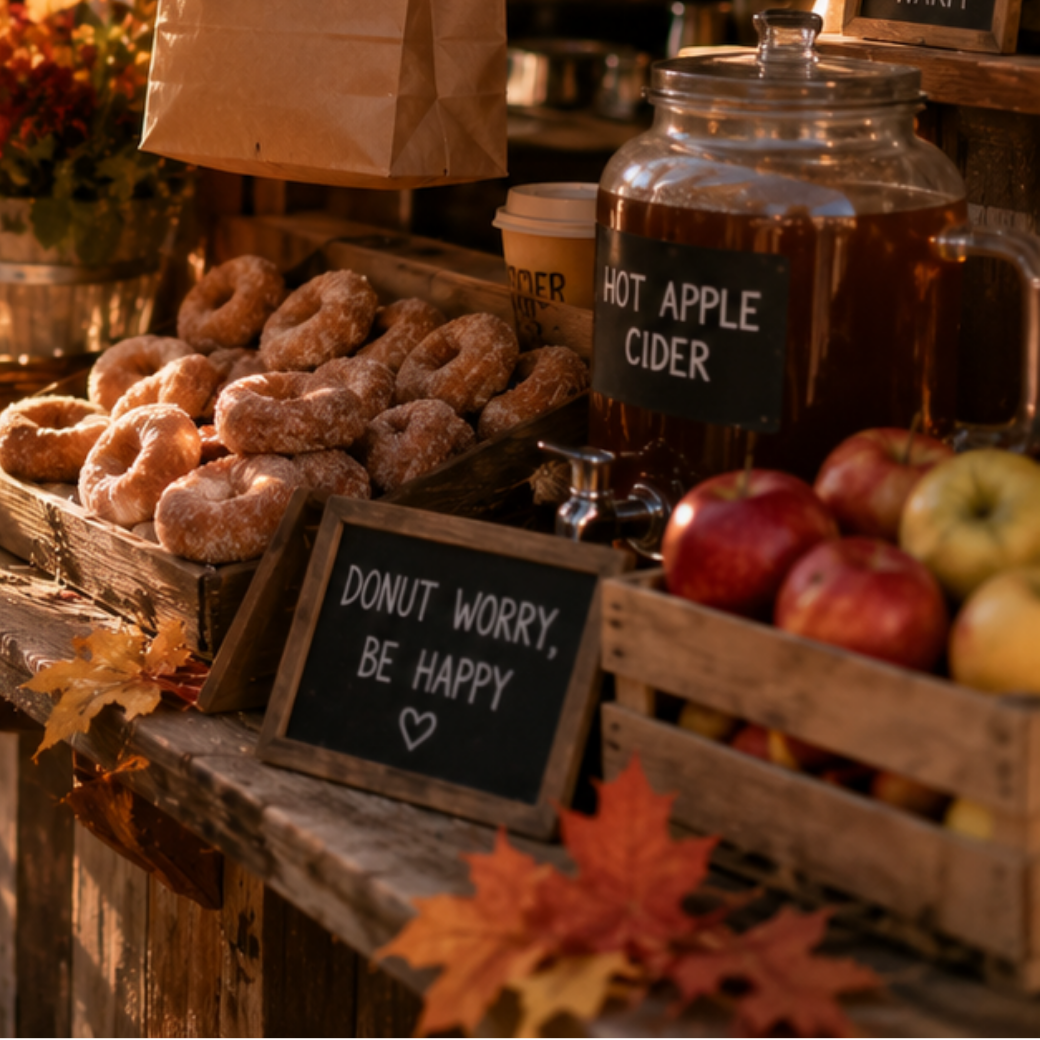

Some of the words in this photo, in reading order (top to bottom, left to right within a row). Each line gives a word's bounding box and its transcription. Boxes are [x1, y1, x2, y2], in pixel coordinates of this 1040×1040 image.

[603, 266, 646, 312] HOT
[659, 281, 762, 332] APPLE
[625, 327, 711, 382] CIDER
[340, 564, 439, 622] DONUT
[453, 588, 560, 660] WORRY,
[357, 635, 400, 683] BE
[412, 649, 515, 711] HAPPY
